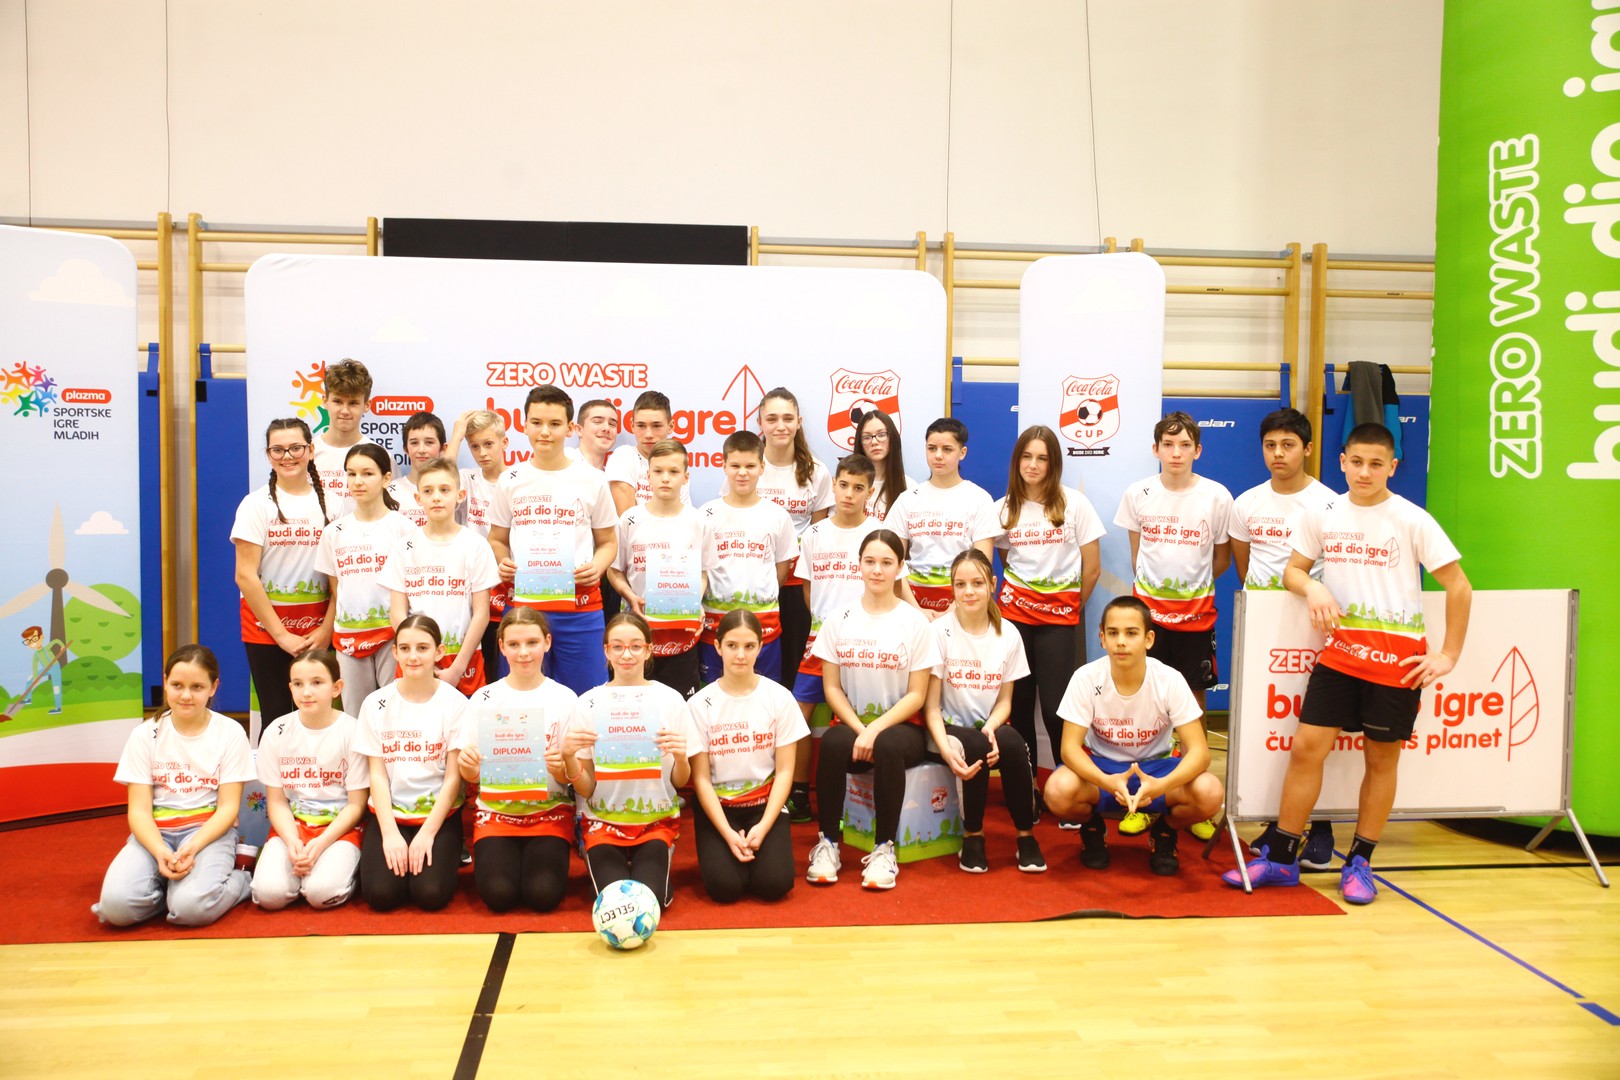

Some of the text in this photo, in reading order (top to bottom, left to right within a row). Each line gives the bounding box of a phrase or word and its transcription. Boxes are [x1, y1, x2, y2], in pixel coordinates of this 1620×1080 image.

[1489, 133, 1542, 479] ZERO WASTE
[486, 362, 648, 388] ZERO WASTE
[835, 375, 895, 395] Coca-Cola
[1066, 379, 1115, 396] Coca-Cola
[65, 390, 106, 401] plazma
[375, 400, 426, 413] plazma
[53, 407, 112, 418] SPORTSKE
[53, 419, 80, 428] IGRE
[361, 422, 405, 435] SPORT
[672, 409, 737, 445] gre
[1197, 419, 1235, 428] elan
[53, 430, 100, 440] MLADIH
[1075, 429, 1103, 438] CUP
[528, 495, 552, 503] WASTE
[788, 497, 806, 508] igre
[534, 505, 575, 518] dio igre
[553, 518, 574, 526] planet
[907, 518, 964, 531] budi dio igre
[1157, 516, 1179, 524] WASTE
[1261, 517, 1284, 525] WASTE
[268, 527, 292, 538] budi
[295, 527, 310, 538] dio
[942, 529, 963, 537] planet
[1024, 528, 1040, 537] dio
[1043, 527, 1063, 539] igre
[1163, 526, 1200, 539] dio igre
[1265, 526, 1282, 537] dio
[1339, 532, 1365, 541] WASTE
[730, 539, 765, 551] dio igre
[1042, 538, 1063, 546] planet
[1178, 538, 1200, 547] planet
[1325, 542, 1389, 558] udi dio igre
[356, 553, 372, 565] dio
[1364, 557, 1387, 567] planet
[833, 561, 846, 571] dio
[428, 575, 444, 587] dio
[657, 582, 690, 590] DIPLOMA
[446, 589, 465, 598] plane
[1052, 606, 1072, 615] CUP
[857, 648, 875, 659] dio
[878, 649, 899, 662] igre
[1370, 650, 1398, 664] CUP
[876, 661, 897, 671] planet
[1269, 648, 1321, 674] ZER
[965, 669, 1002, 683] dio igre
[1434, 682, 1504, 727] igre
[608, 725, 646, 734] DIPLOMA
[723, 721, 749, 732] WASTE
[709, 731, 773, 747] udi dio igre
[1117, 728, 1158, 740] dio igre
[404, 741, 422, 752] dio
[1426, 728, 1502, 755] planet
[493, 747, 532, 755] DIPLOMA
[279, 756, 295, 765] ERO
[174, 772, 193, 784] dio
[280, 767, 342, 783] udi igre
[600, 902, 635, 925] SELECT
